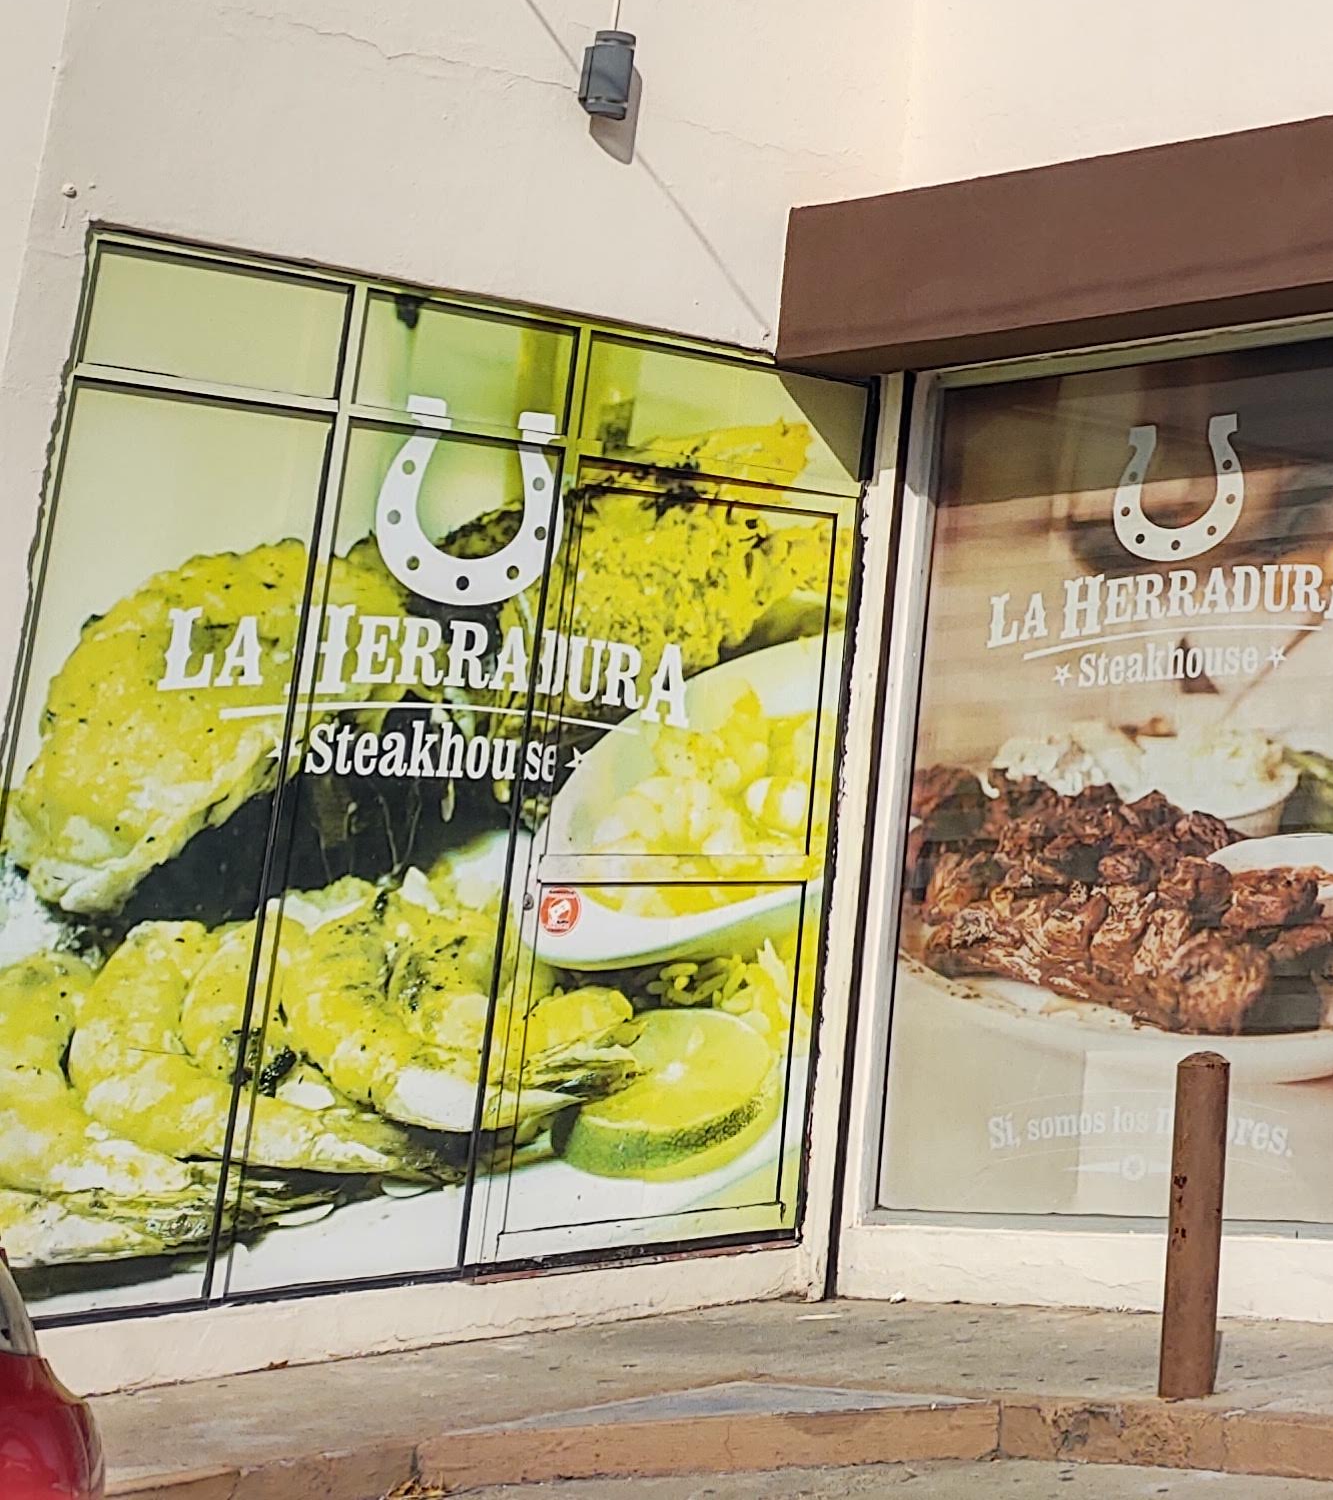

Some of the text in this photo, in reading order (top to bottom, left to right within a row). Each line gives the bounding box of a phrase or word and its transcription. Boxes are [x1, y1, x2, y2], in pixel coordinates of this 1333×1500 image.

[156, 605, 263, 692] LA
[986, 592, 1049, 650] LA
[1078, 641, 1260, 689] Steakhouse
[303, 717, 556, 783] Steakhouse
[1027, 1108, 1106, 1141] somos
[1112, 1105, 1150, 1134] los
